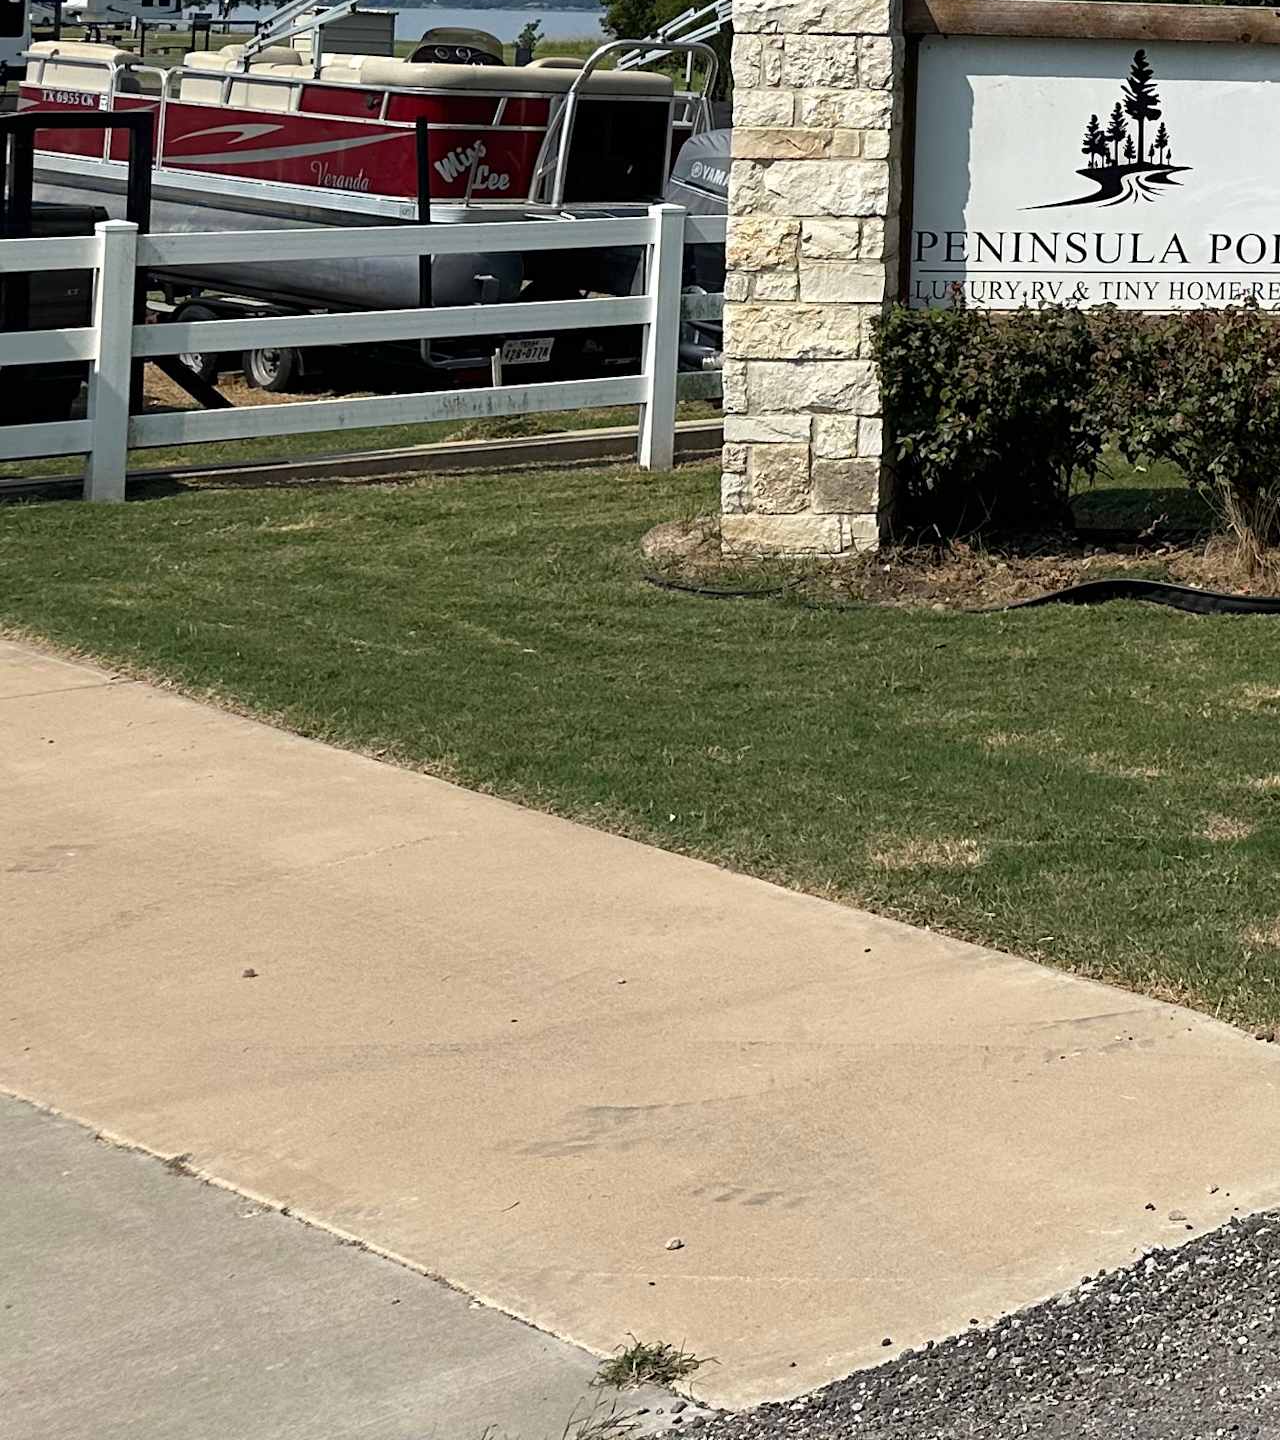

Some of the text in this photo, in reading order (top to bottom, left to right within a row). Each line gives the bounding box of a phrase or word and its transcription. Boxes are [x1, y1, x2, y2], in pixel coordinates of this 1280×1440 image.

[42, 90, 55, 102] TX
[56, 91, 79, 105] 6955
[81, 93, 94, 106] CK
[310, 160, 370, 191] Veranda
[471, 165, 510, 190] Lee
[914, 231, 1191, 264] PENINSULA
[1031, 281, 1063, 300] RV
[1072, 281, 1089, 300] &
[1099, 281, 1160, 300] TINY
[1168, 281, 1241, 300] HOME
